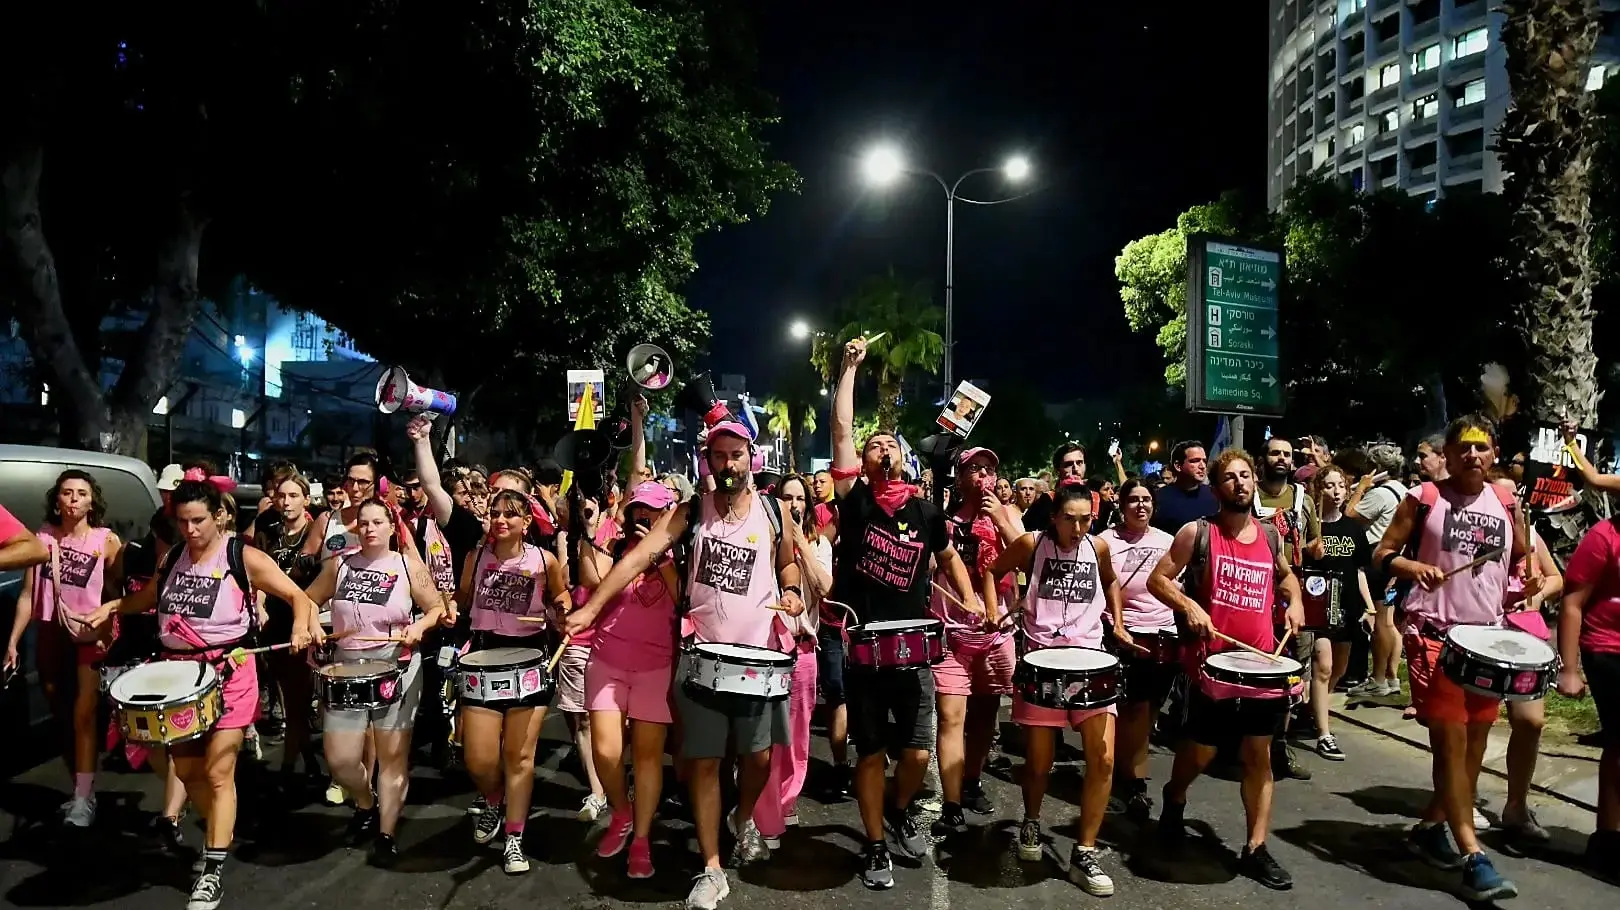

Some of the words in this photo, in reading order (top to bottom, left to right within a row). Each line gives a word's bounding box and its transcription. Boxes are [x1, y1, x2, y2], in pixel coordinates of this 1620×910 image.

[1240, 262, 1268, 274] מוזיאון
[1213, 288, 1241, 299] Tel-Aviv
[1210, 356, 1241, 368] המדינה
[1244, 359, 1264, 370] כיכר
[1212, 386, 1249, 398] Hamedina
[1251, 389, 1263, 400] Sq.
[1453, 510, 1501, 530] VICTORY
[1450, 527, 1501, 547] HOSTGE
[708, 539, 751, 562] VICTORY
[867, 530, 917, 564] PINKFRONT
[60, 550, 91, 565] CTORY
[705, 560, 748, 580] HOSTAGE
[1049, 560, 1091, 575] VICTORY
[1221, 561, 1267, 585] PINKFRONT
[175, 573, 215, 589] VICTORY
[351, 570, 390, 583] VICTORY
[487, 571, 530, 587] VICTORY
[710, 574, 735, 590] DEAL
[1046, 577, 1093, 590] HOSTAGE
[344, 581, 388, 594] HOSTAGE
[481, 587, 528, 602] HOSTAGE
[166, 592, 211, 605] HOSTAGE
[345, 590, 373, 601] DEAL
[168, 603, 196, 615] DEAL
